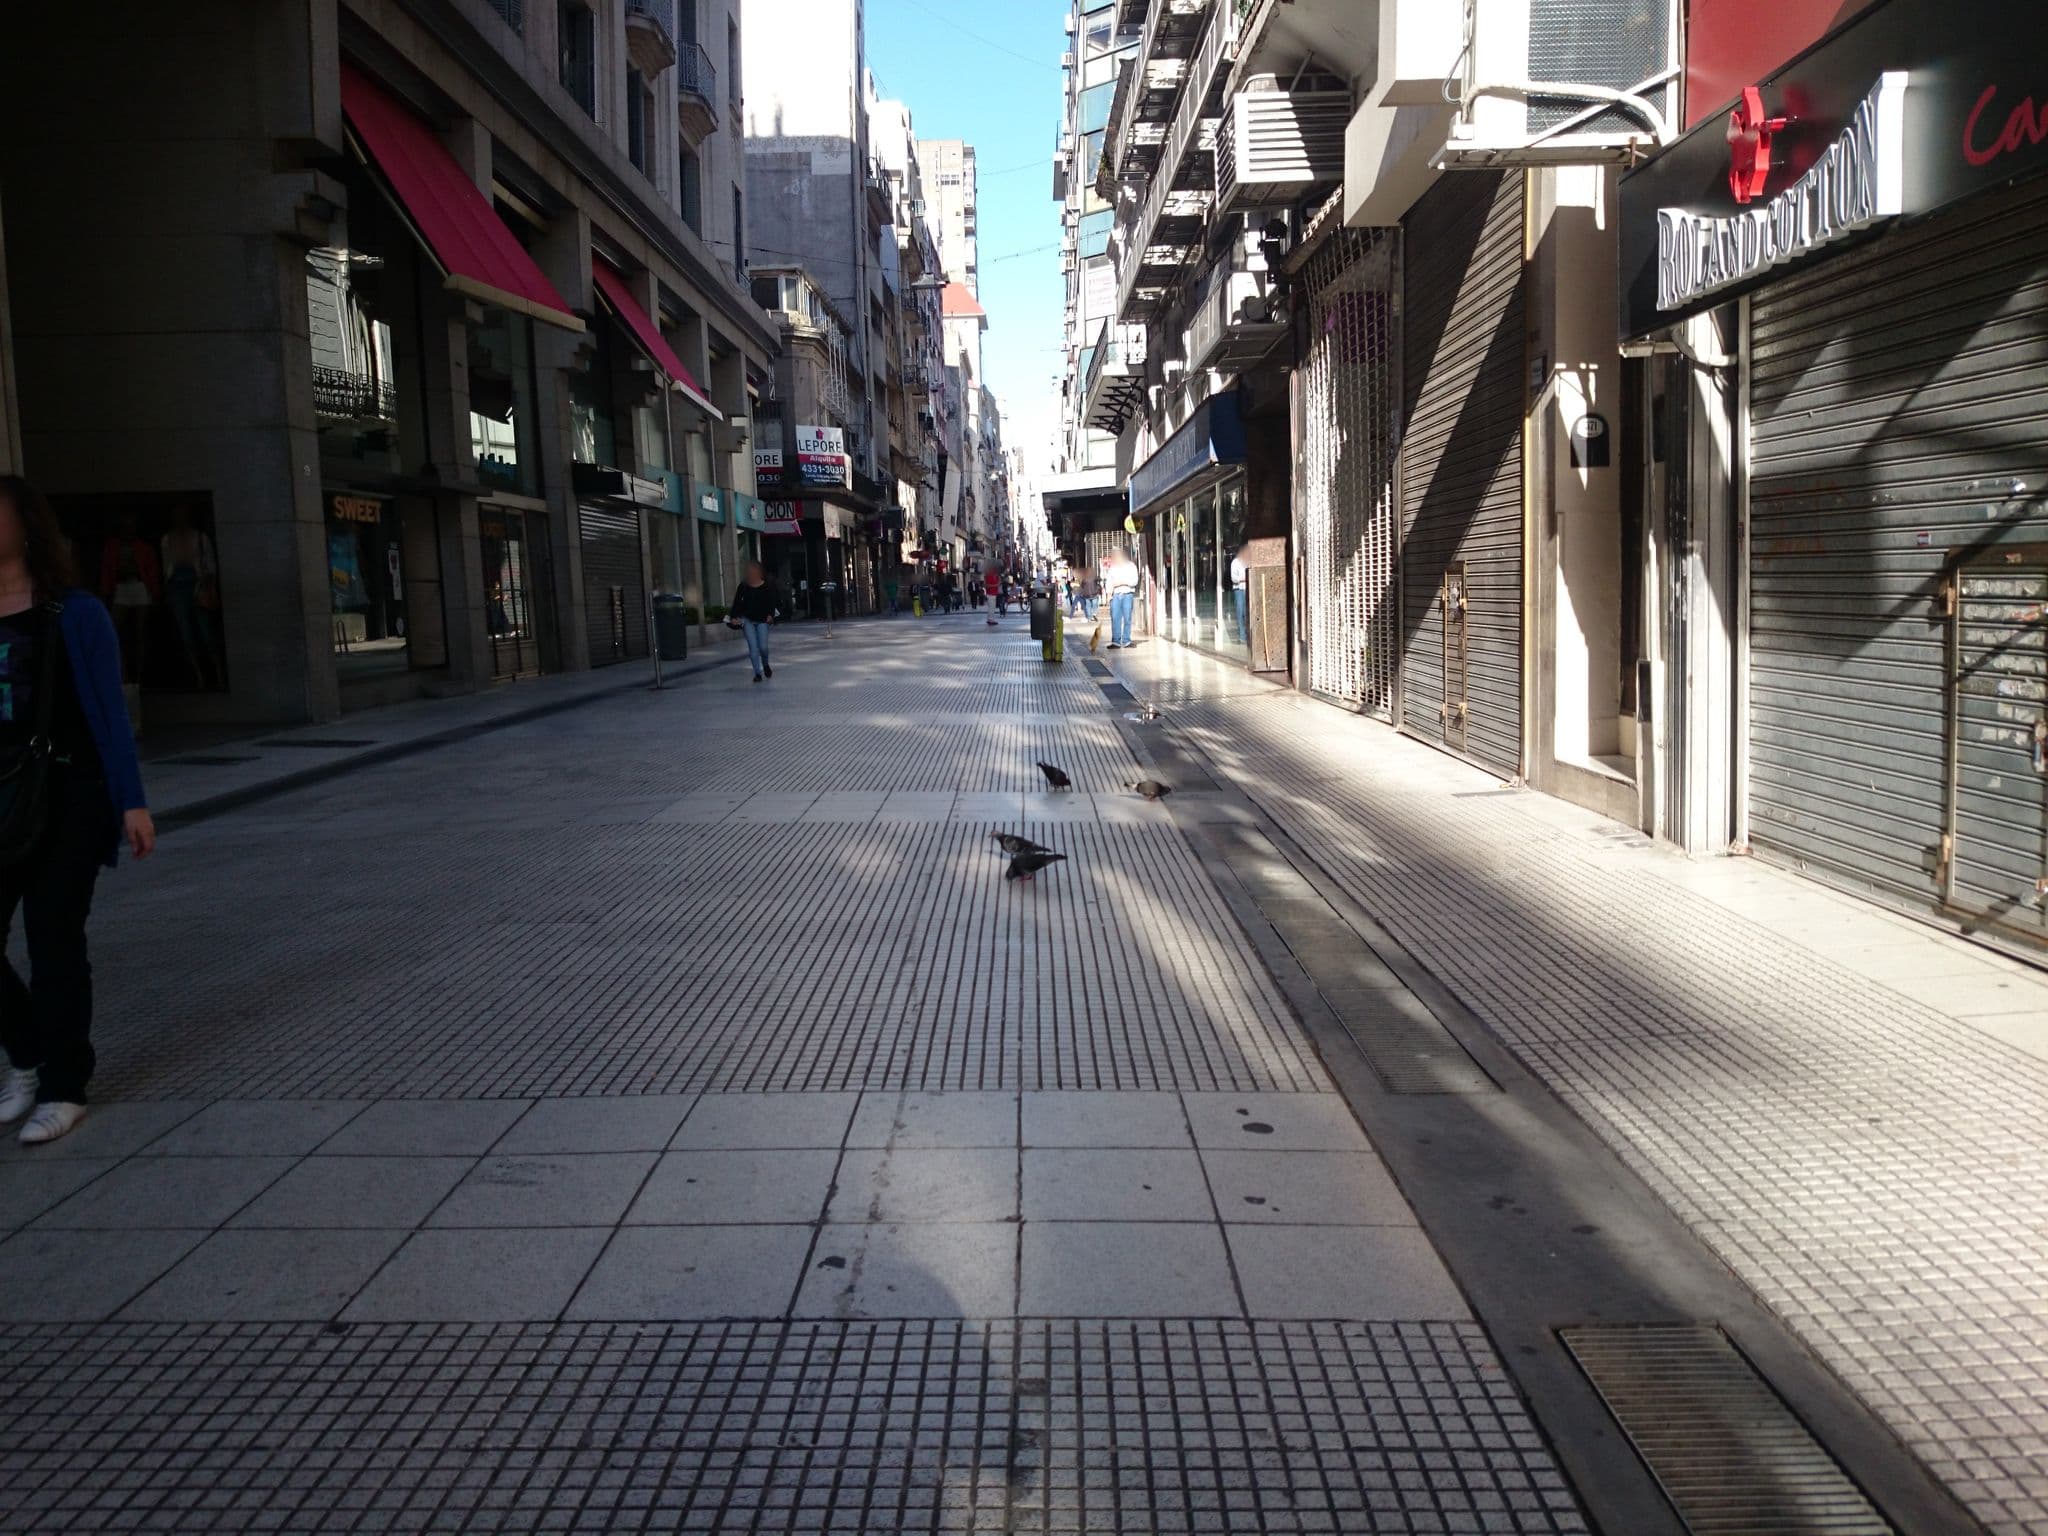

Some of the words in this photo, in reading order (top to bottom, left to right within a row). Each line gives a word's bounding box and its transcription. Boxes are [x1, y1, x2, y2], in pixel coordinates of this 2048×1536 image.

[798, 439, 843, 453] LEPORE
[754, 454, 779, 465] ORE
[801, 464, 845, 474] 4331-3030
[333, 496, 382, 523] SWEET
